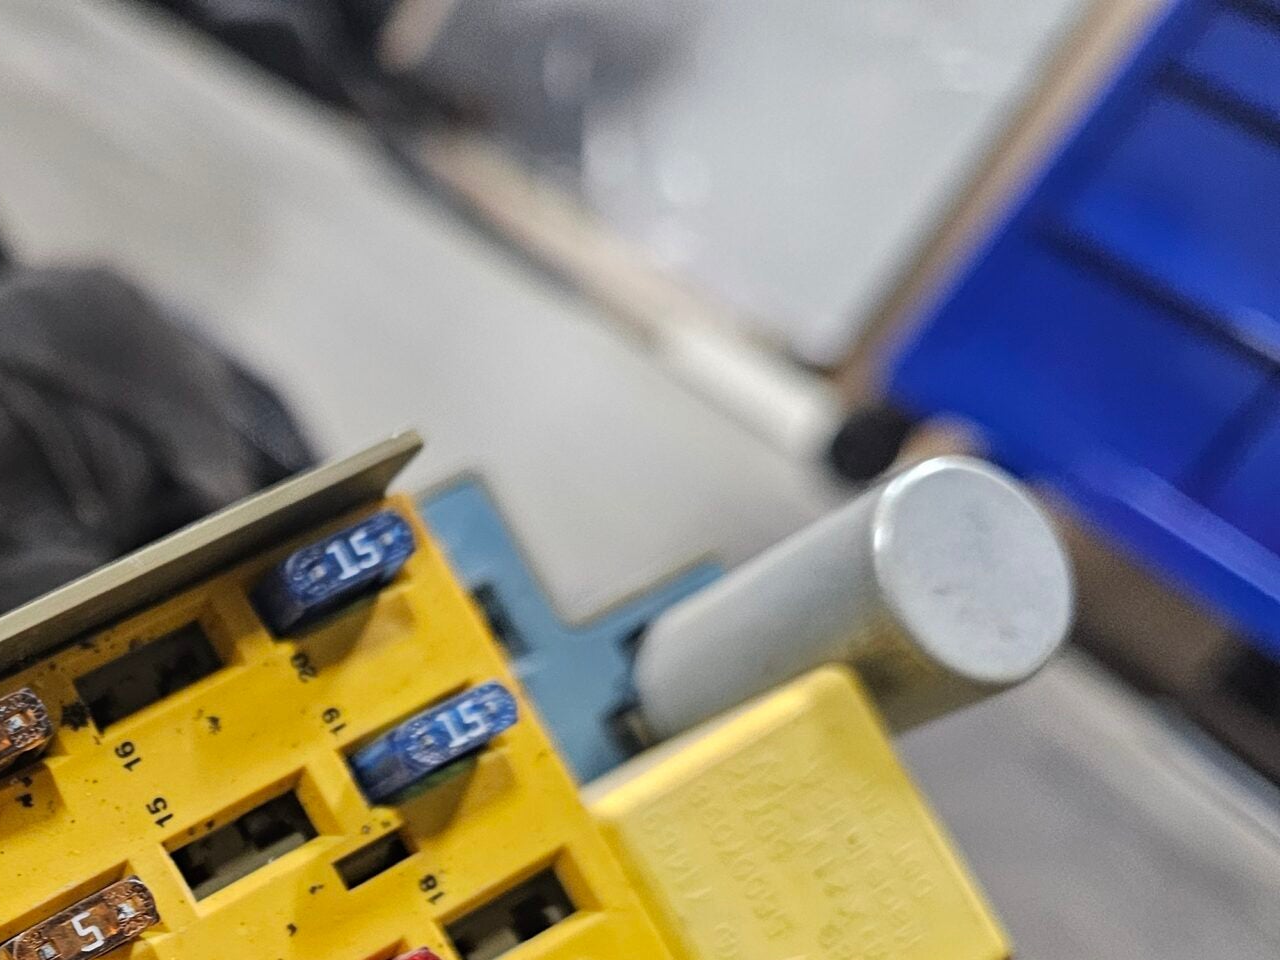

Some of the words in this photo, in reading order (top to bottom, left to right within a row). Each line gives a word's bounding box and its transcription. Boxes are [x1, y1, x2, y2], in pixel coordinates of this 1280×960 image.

[327, 530, 383, 580] 15
[290, 653, 316, 682] 20
[322, 707, 348, 736] 19
[435, 702, 489, 748] 15
[114, 741, 142, 773] 16
[145, 796, 175, 828] 15
[419, 875, 445, 905] 18
[71, 912, 104, 952] 5
